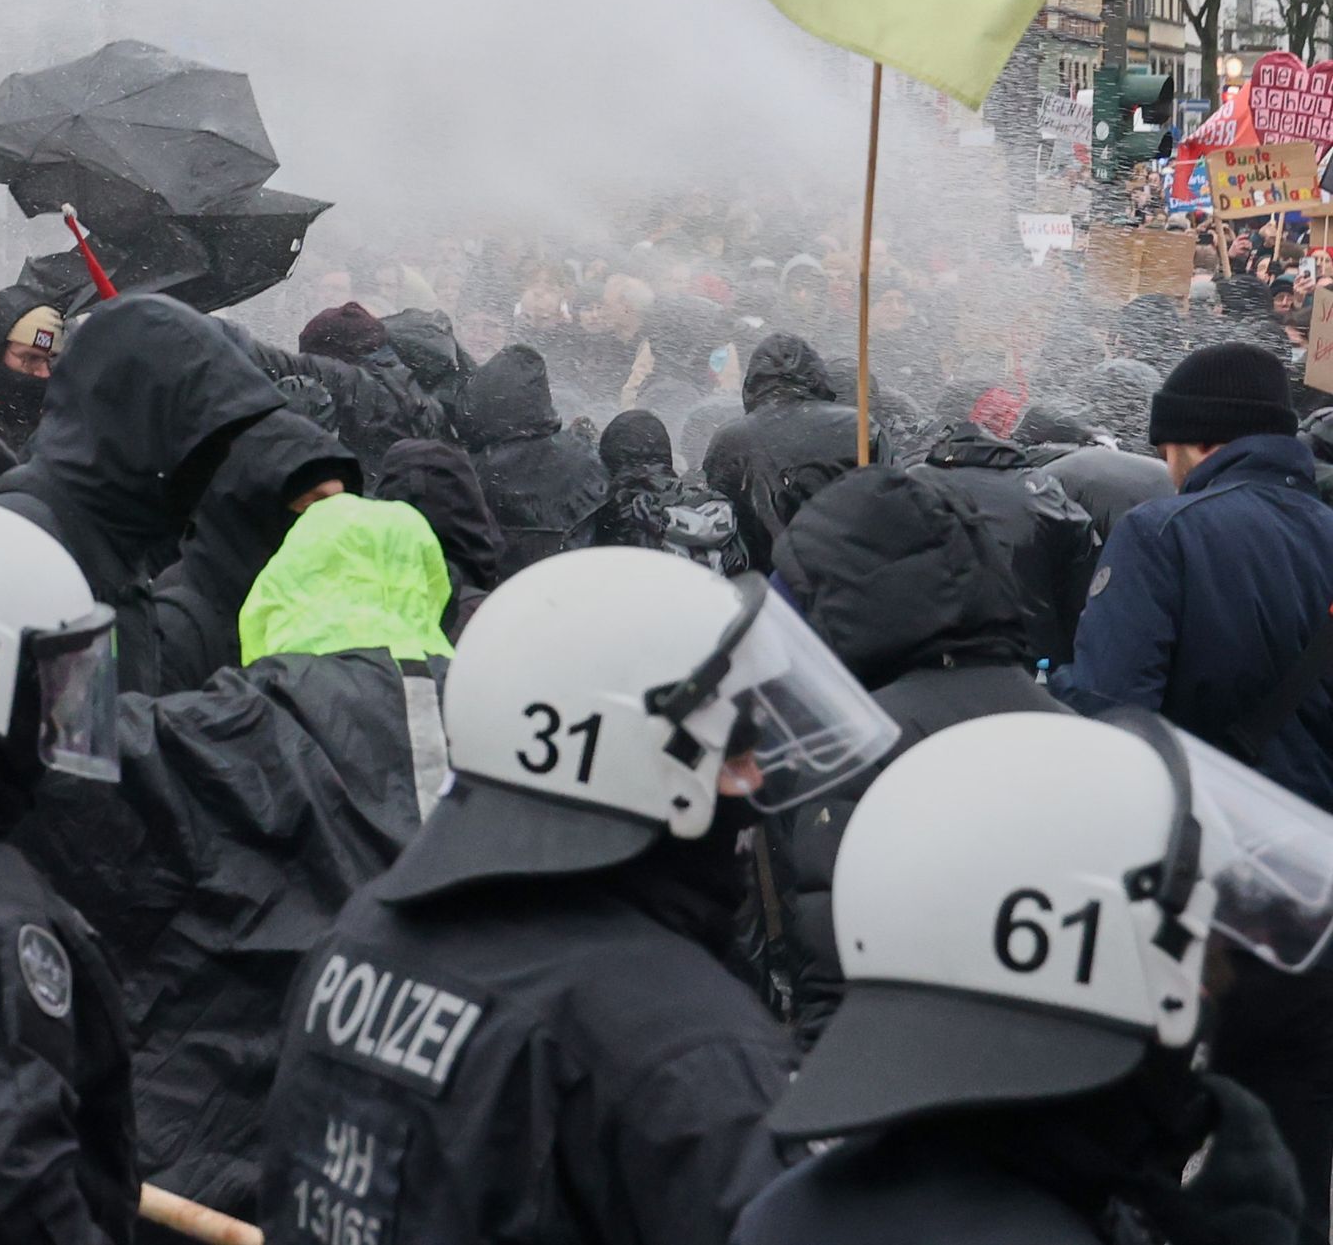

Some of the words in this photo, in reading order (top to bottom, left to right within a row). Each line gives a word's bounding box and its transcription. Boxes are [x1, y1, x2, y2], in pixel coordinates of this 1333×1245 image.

[1262, 66, 1333, 94] Mein
[1225, 148, 1271, 166] Bunte
[1217, 162, 1291, 190] Republik
[1219, 175, 1322, 211] Deutschland
[515, 702, 603, 785] 31
[993, 887, 1103, 986] 61
[304, 955, 483, 1084] POLIZEI
